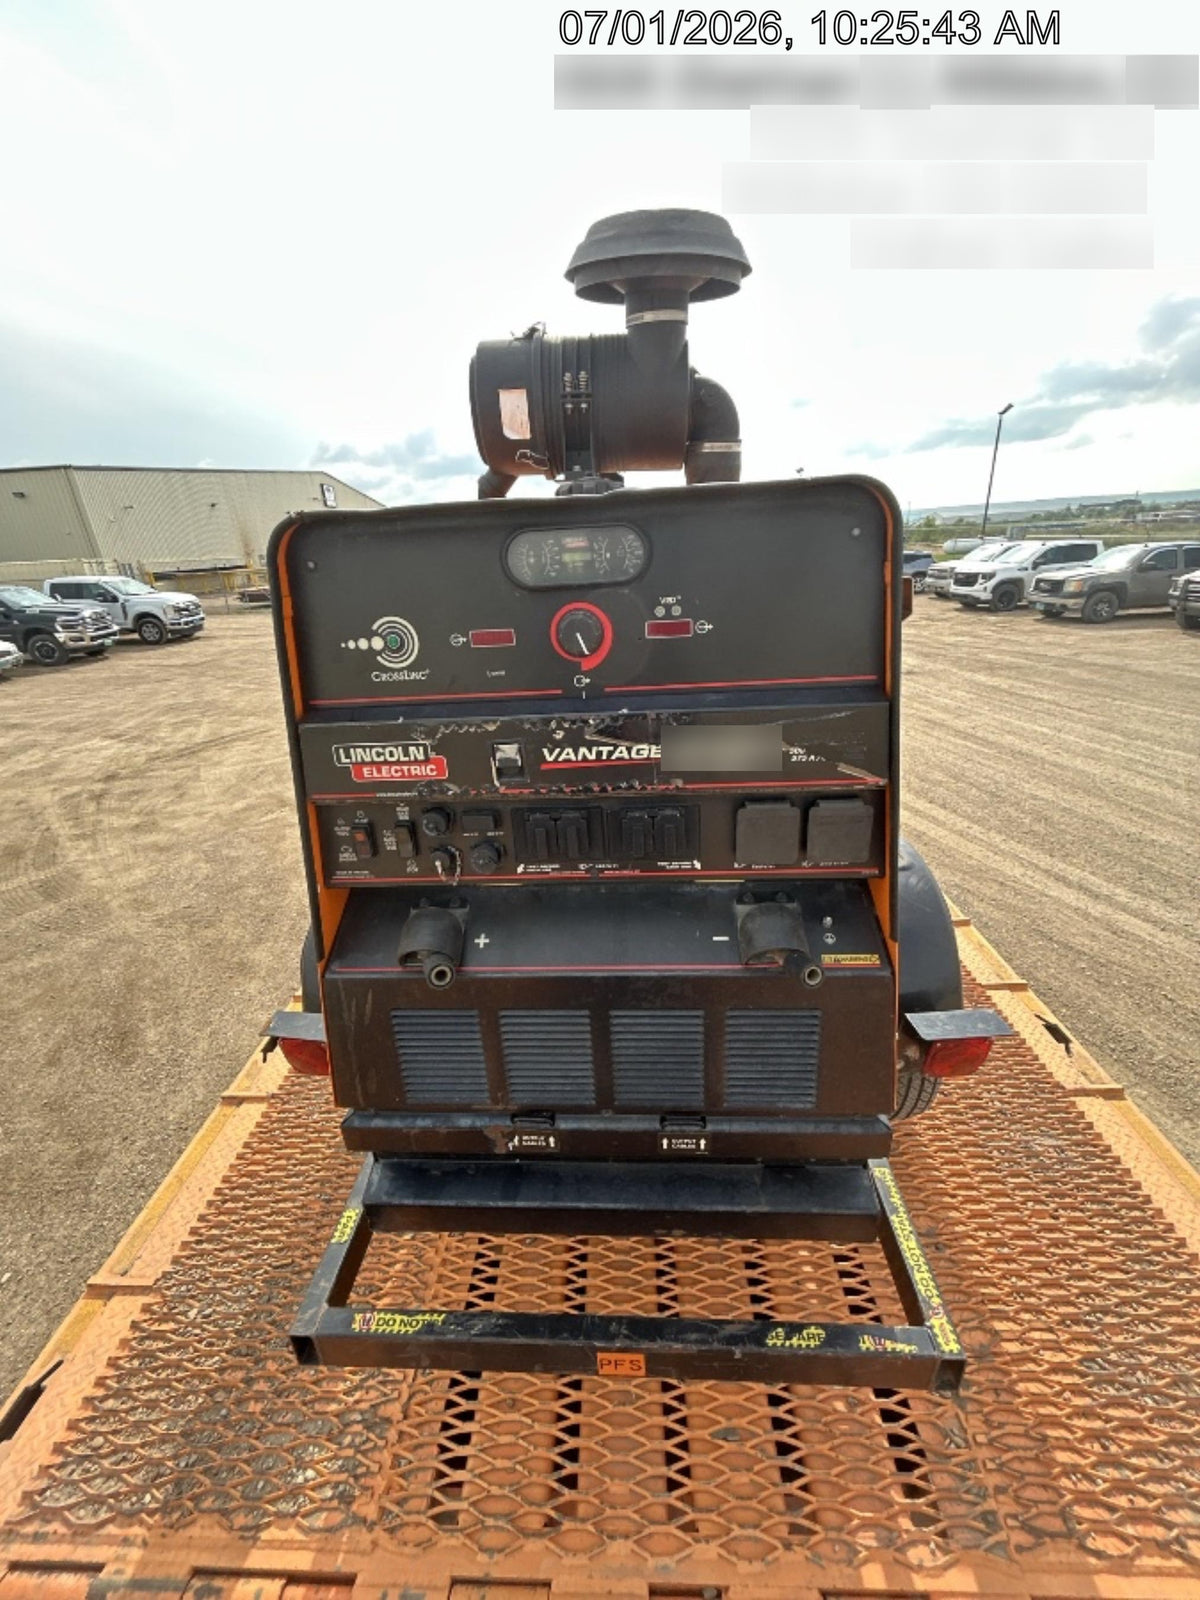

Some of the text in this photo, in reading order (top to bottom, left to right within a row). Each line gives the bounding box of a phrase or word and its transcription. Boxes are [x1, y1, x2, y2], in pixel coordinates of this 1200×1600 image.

[338, 745, 425, 764] LINCOLN
[542, 743, 661, 762] VANTAGE
[363, 764, 438, 778] ELECTRIC
[375, 1318, 396, 1327] DO
[599, 1357, 643, 1371] PFS
